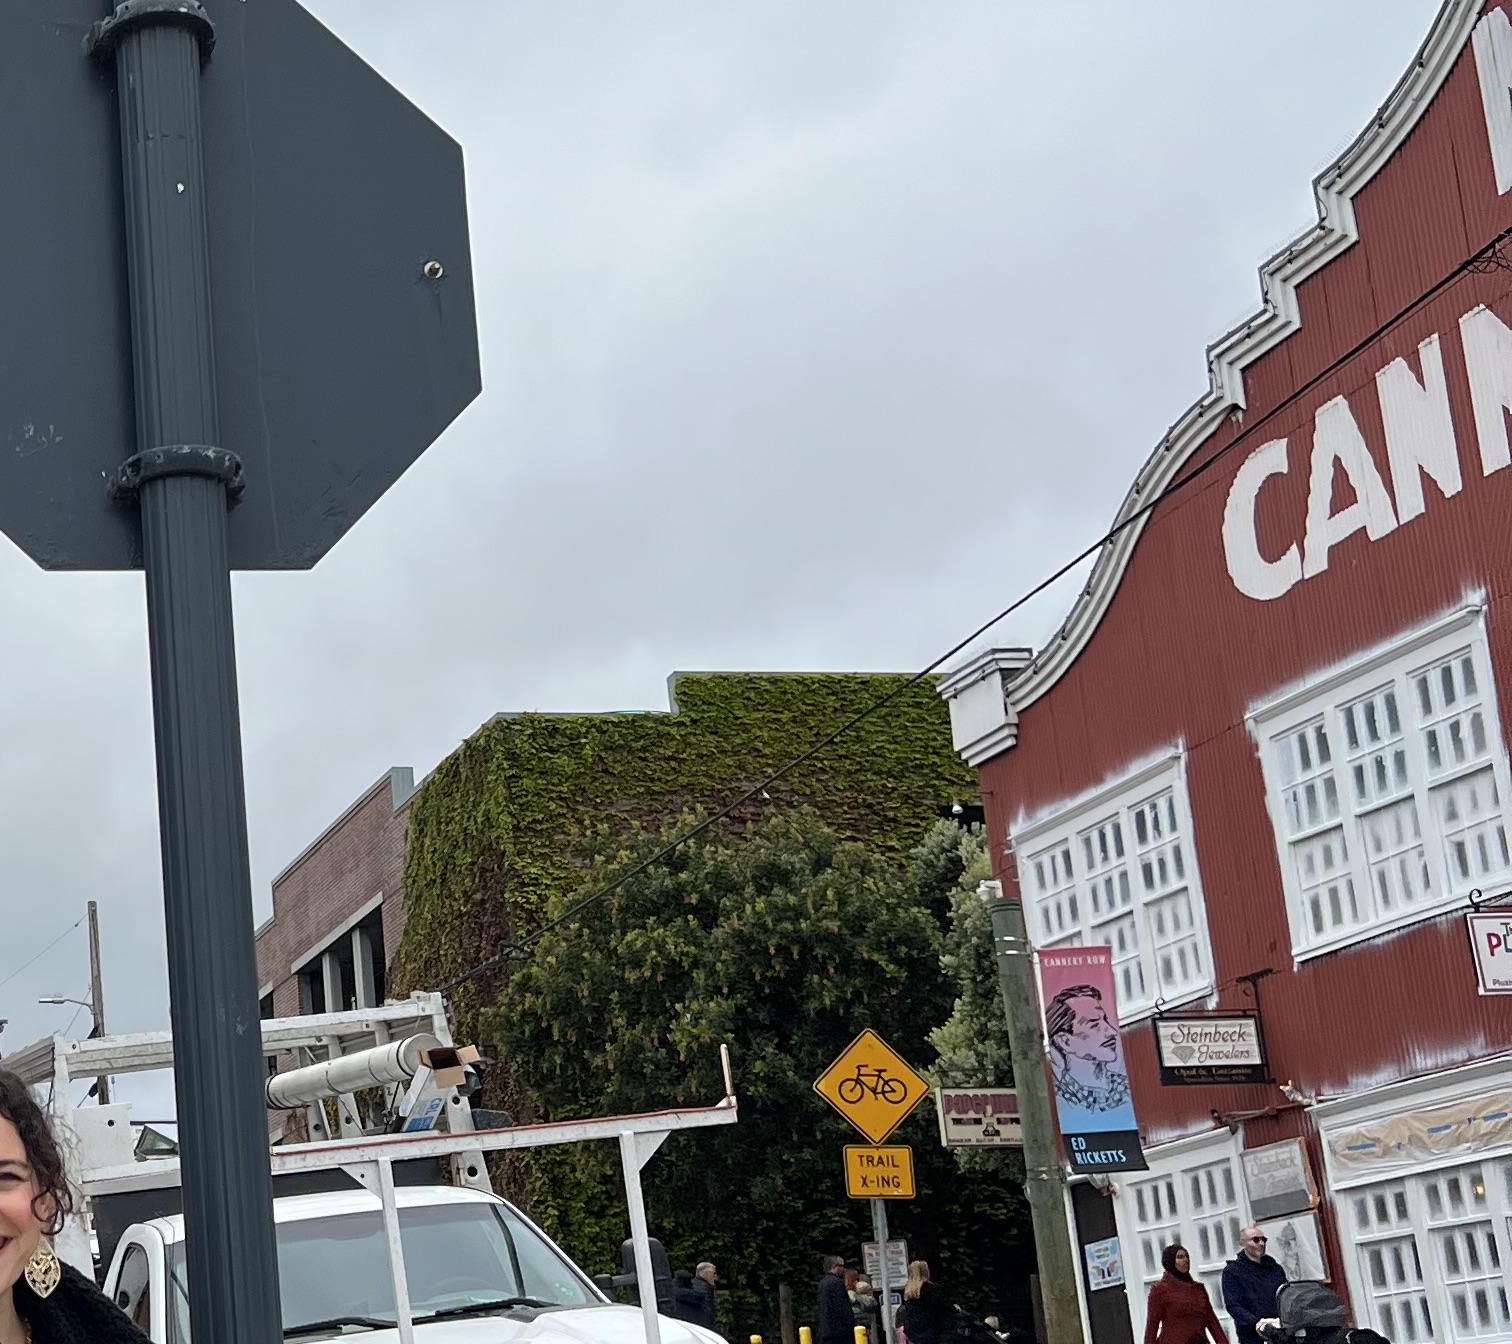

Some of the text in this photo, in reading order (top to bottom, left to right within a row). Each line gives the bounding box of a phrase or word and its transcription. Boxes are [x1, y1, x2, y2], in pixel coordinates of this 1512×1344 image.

[1171, 1023, 1247, 1045] Steinbeck
[1197, 1044, 1250, 1064] Jewelers
[1071, 1137, 1086, 1150] ED
[857, 1154, 900, 1168] TRAIL
[1075, 1149, 1127, 1165] RICKETTS
[860, 1174, 901, 1188] X-ING
